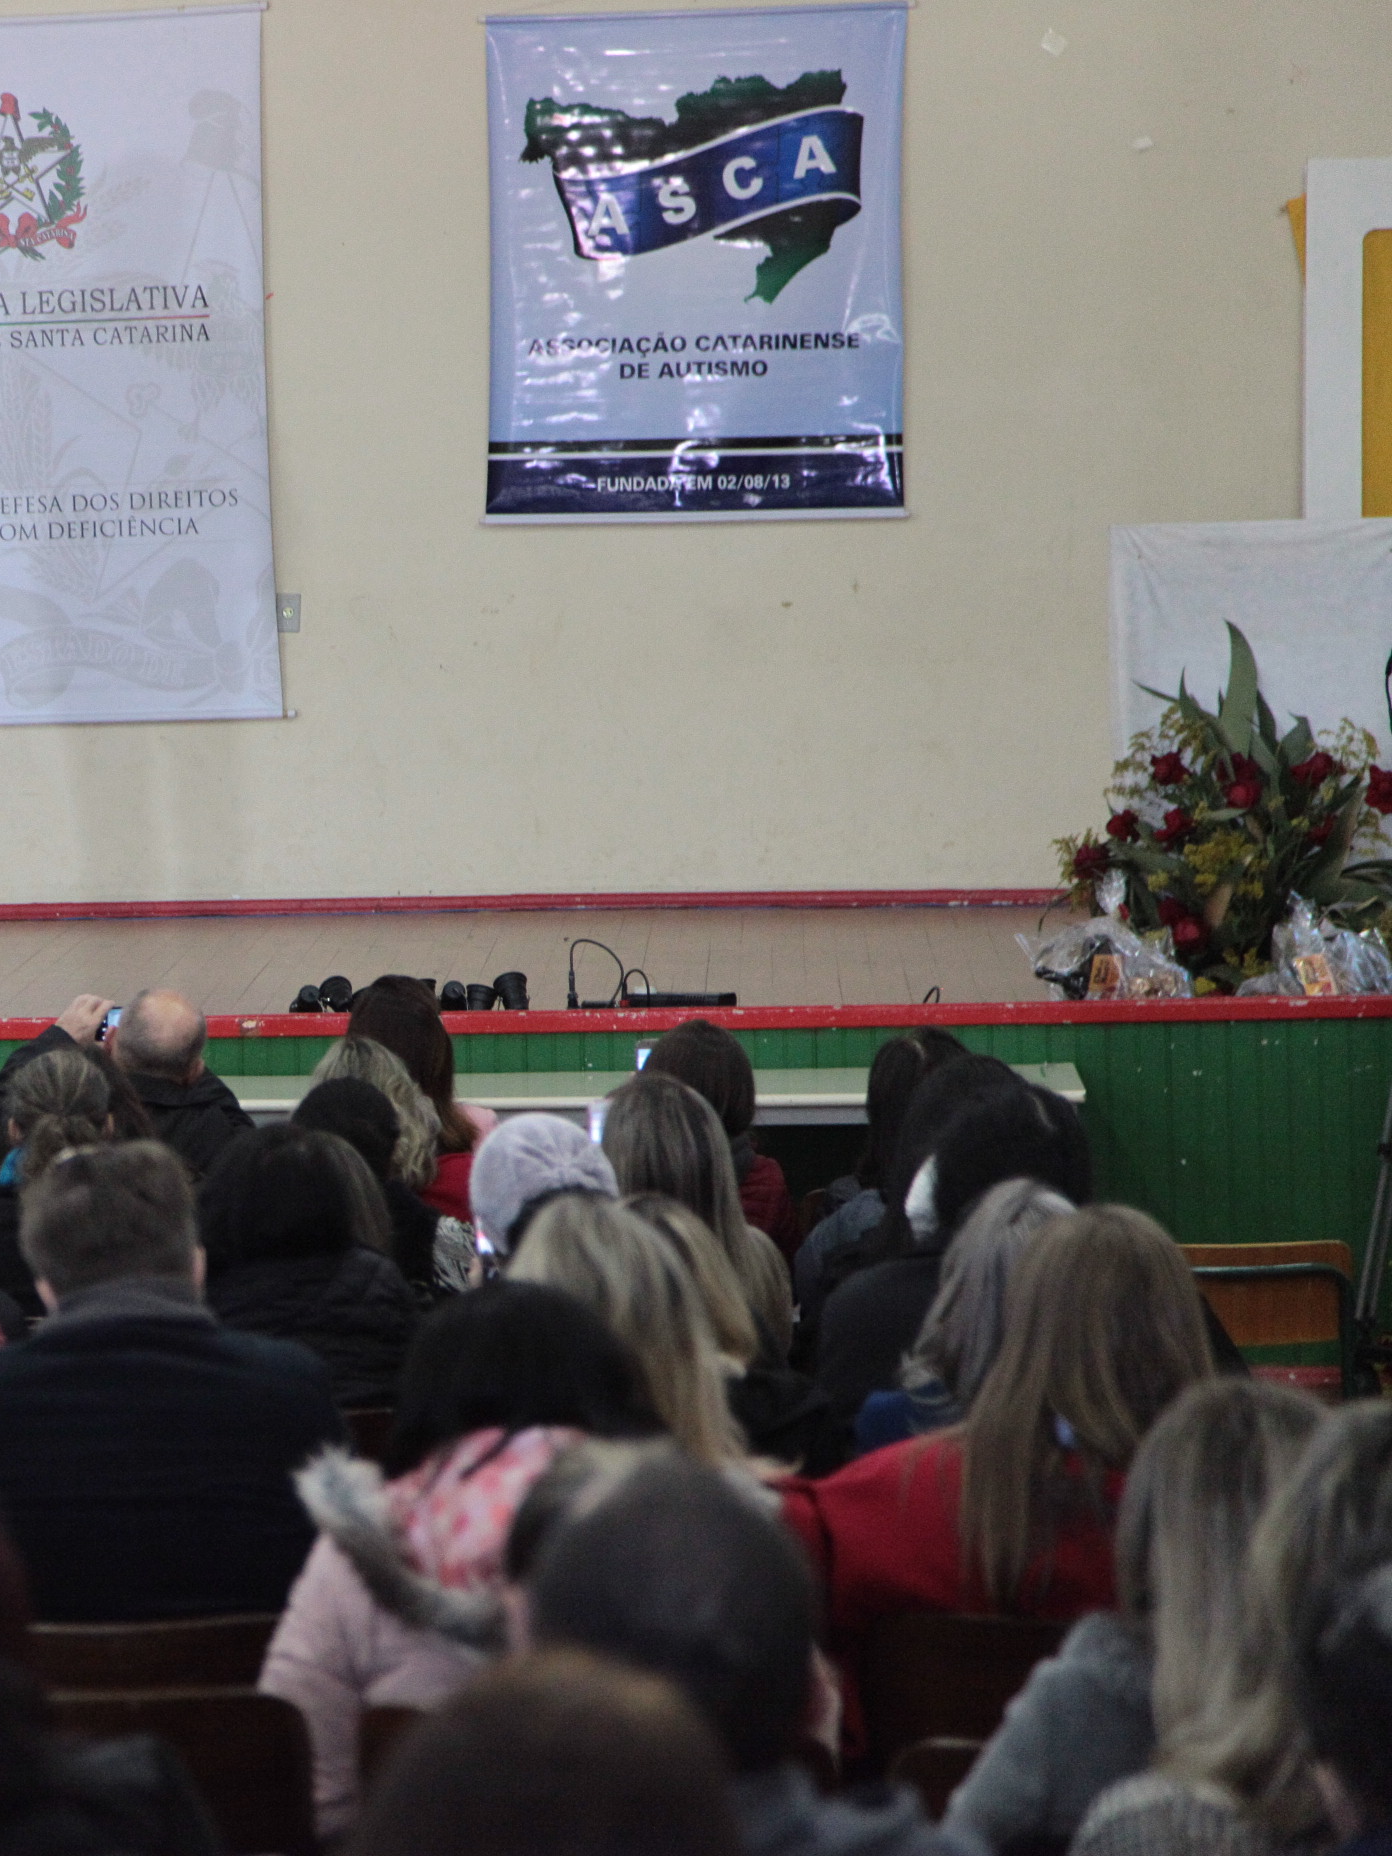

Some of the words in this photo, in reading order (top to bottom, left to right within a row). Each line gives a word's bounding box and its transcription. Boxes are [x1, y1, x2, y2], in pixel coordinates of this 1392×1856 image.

[20, 284, 210, 316] LEGISLATIVA
[10, 328, 85, 349] SANTA
[93, 323, 211, 346] CATARINA
[694, 332, 861, 352] CATARINENSE
[619, 363, 651, 380] DE
[658, 360, 768, 379] AUTISMO
[717, 474, 791, 490] 02/08/13
[72, 492, 120, 513] DOS
[129, 487, 239, 511] DIREITOS
[48, 515, 200, 541] DEFICIÊNCIA
